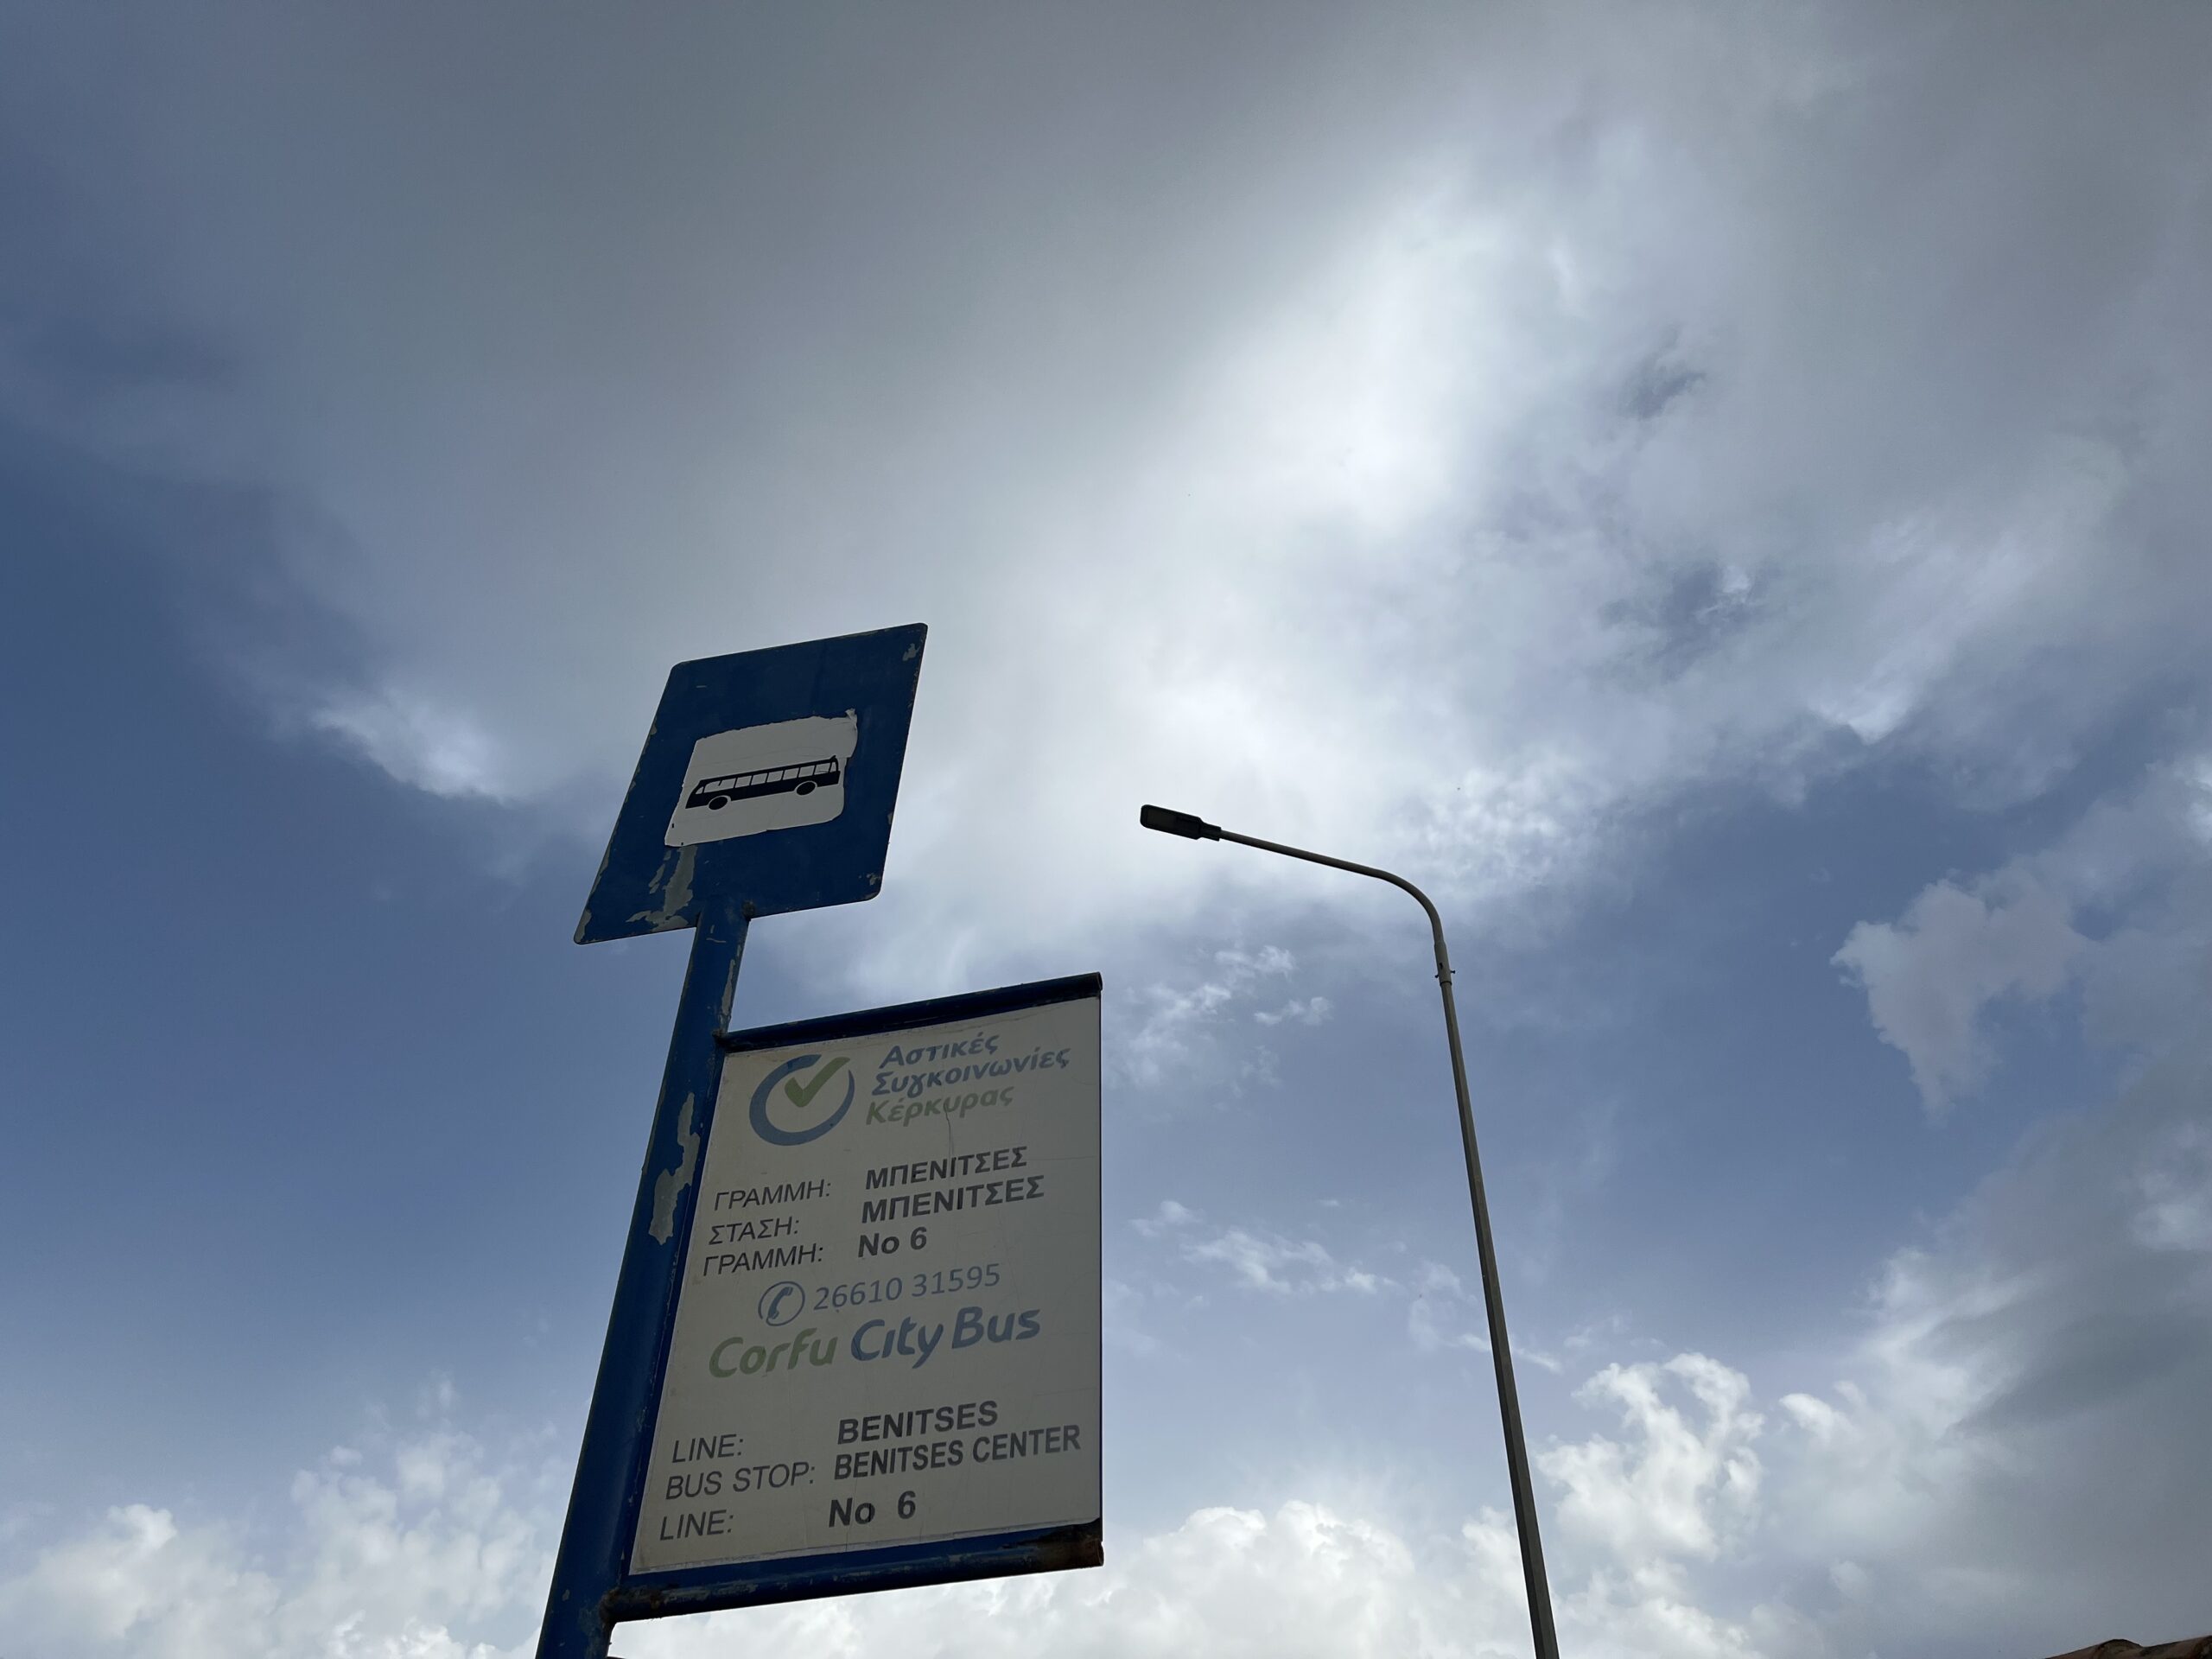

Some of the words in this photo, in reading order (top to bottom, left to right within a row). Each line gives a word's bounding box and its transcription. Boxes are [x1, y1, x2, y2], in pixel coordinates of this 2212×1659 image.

[872, 1046, 1071, 1099] Συγκοινωνίες
[880, 1032, 1000, 1069] Αστικές
[866, 1086, 1014, 1127] Κέρκυρας
[714, 1179, 831, 1211] ΓΡΑΜΜΗ:
[865, 1146, 1027, 1190] ΜΠΕΝΙΤΣΕΣ
[709, 1217, 799, 1245] ΣΤΑΣΗ:
[861, 1175, 1045, 1224] ΜΠΕΝΙΤΣΕΣ
[703, 1243, 823, 1276] ΓΡΑΜΜΗ:
[858, 1231, 899, 1258] No
[910, 1226, 927, 1250] 6
[813, 1277, 902, 1310] 26610
[912, 1262, 1001, 1297] 31595
[709, 1327, 838, 1378] Corfu
[951, 1306, 1040, 1349] Bus
[672, 1433, 744, 1464] LINE:
[837, 1400, 998, 1445] BENITSES
[665, 1470, 722, 1499] BUS
[732, 1461, 816, 1492] STOP:
[834, 1440, 964, 1480] BENITSES
[972, 1424, 1081, 1464] CENTER
[659, 1510, 734, 1541] LINE:
[828, 1497, 875, 1528] No
[898, 1491, 916, 1520] 6
